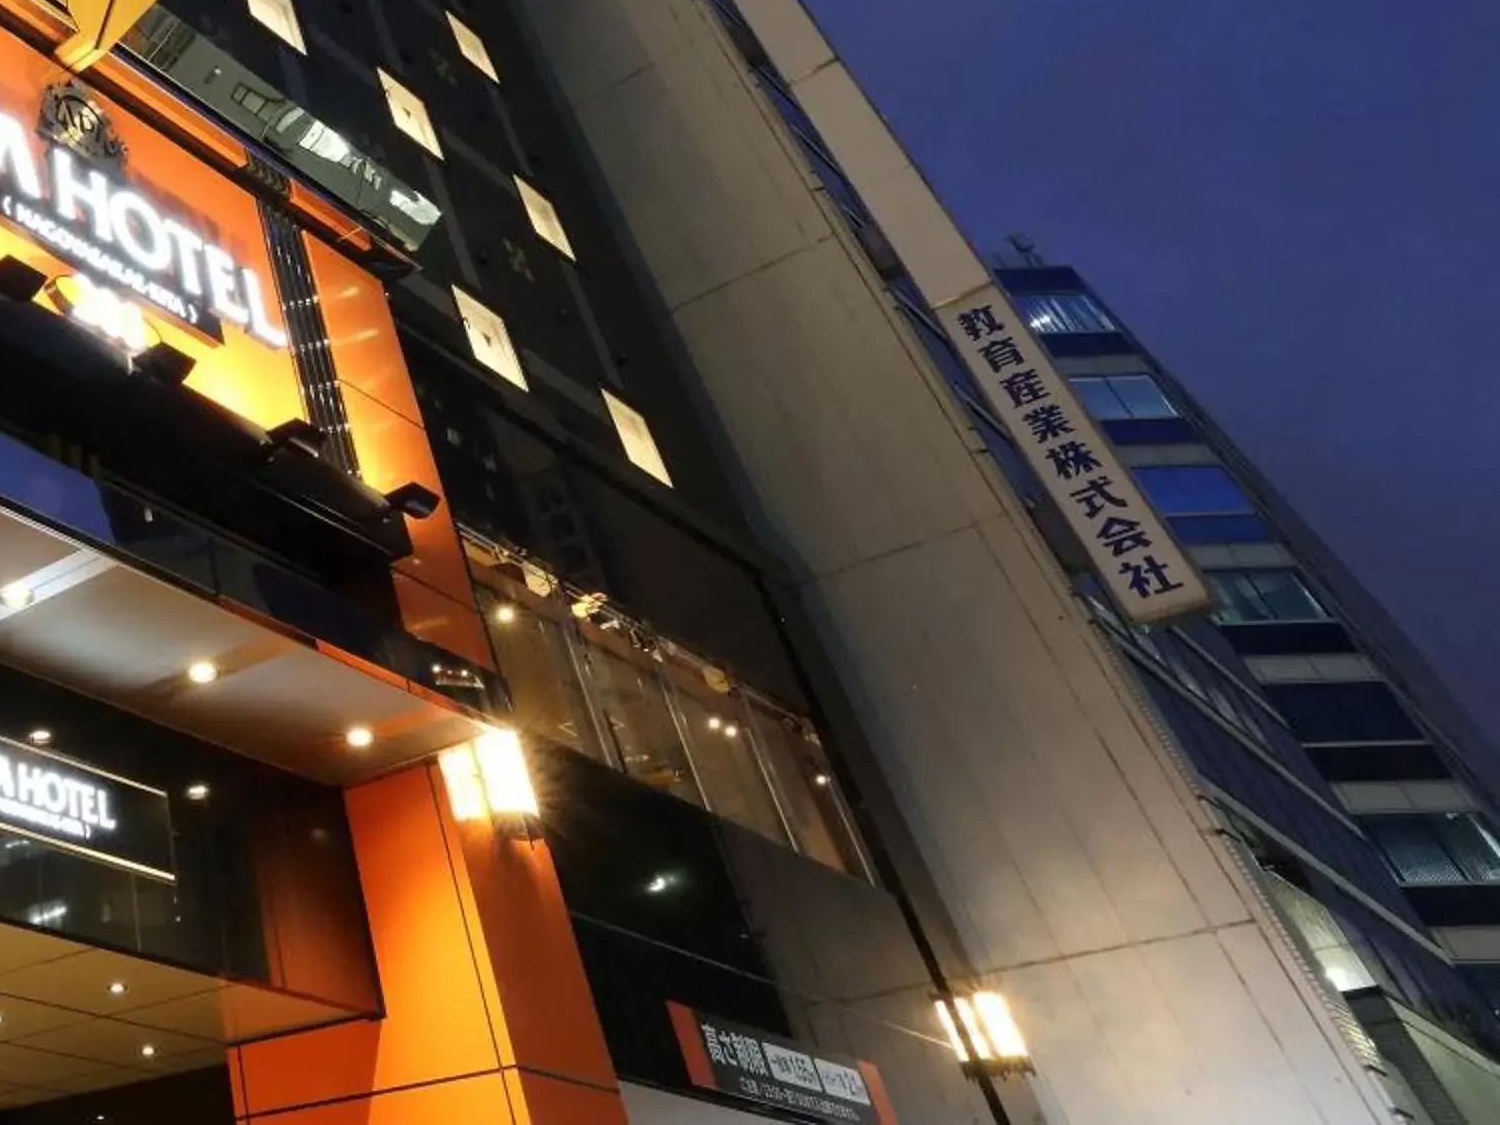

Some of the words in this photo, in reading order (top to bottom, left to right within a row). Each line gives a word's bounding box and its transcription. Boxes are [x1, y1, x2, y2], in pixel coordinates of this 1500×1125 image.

[55, 152, 288, 347] HOTEL
[957, 304, 1184, 599] 教育産業株式会社
[19, 764, 116, 829] HOTEL
